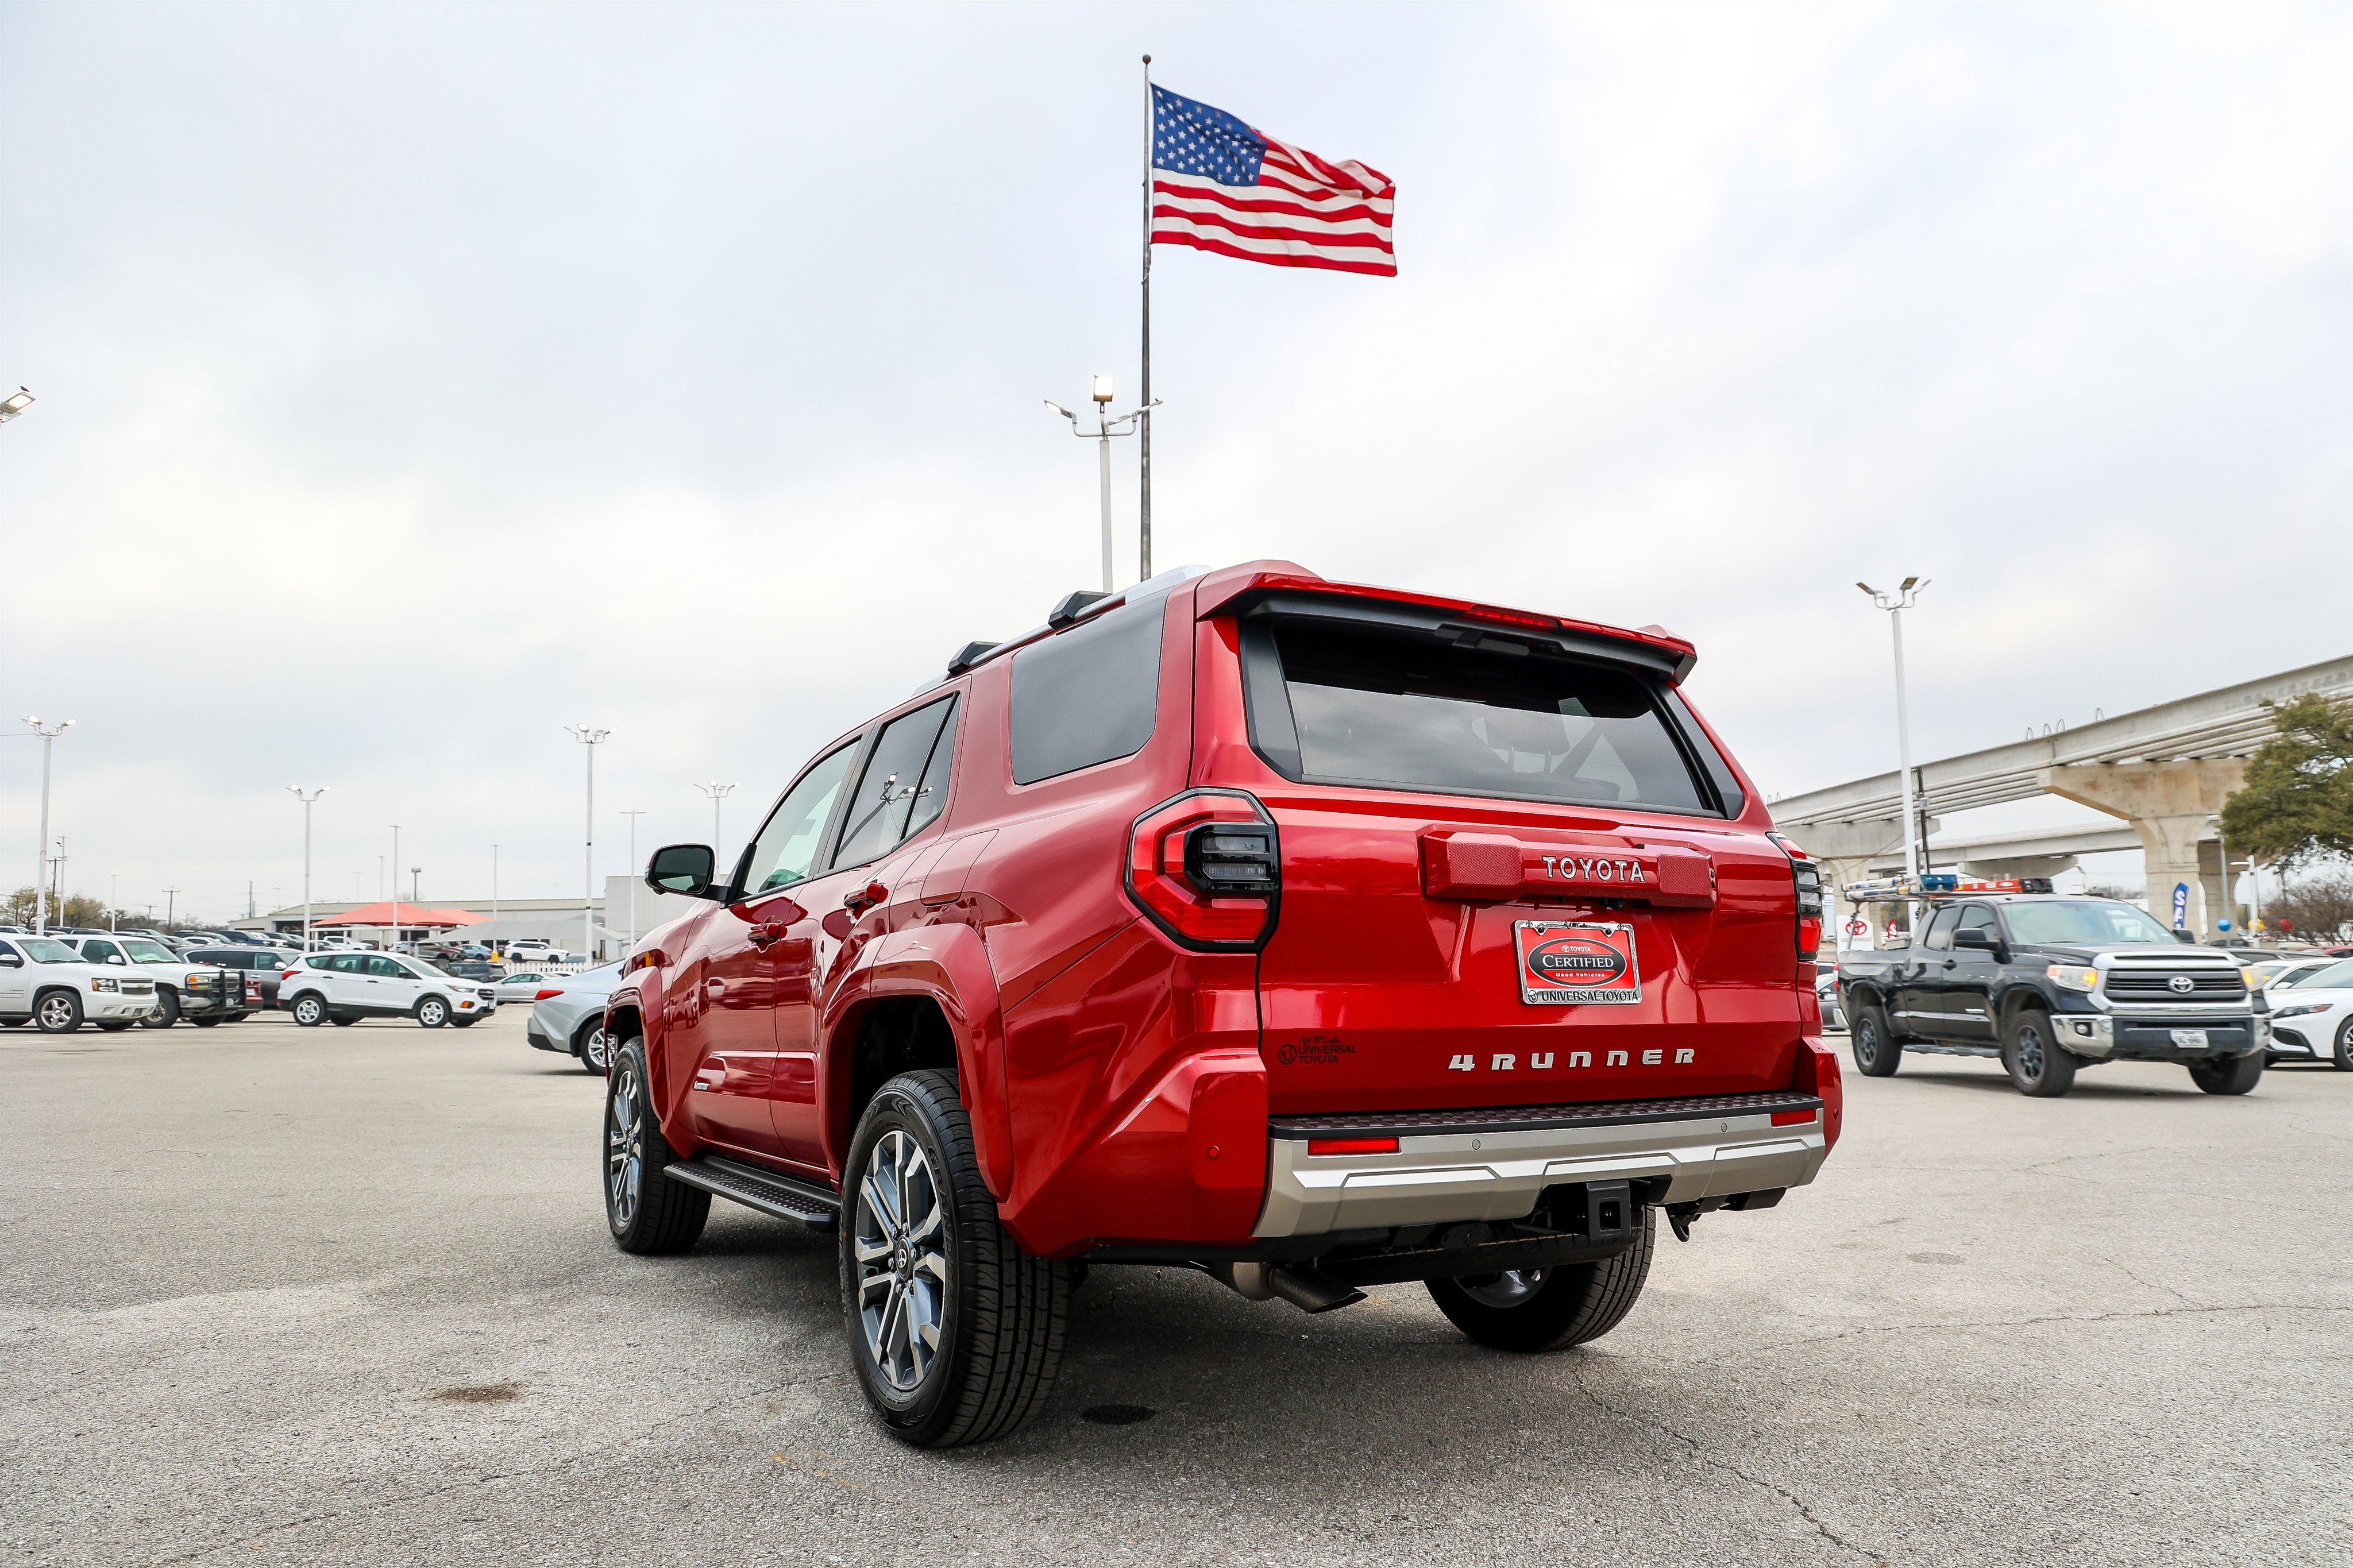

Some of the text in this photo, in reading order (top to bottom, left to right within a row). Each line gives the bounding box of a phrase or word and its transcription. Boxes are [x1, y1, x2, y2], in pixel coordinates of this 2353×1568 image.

[1542, 855, 1645, 883] TOYOTA
[1542, 955, 1614, 968] CERTIFIED
[1541, 990, 1638, 1002] UNIVERSAL TOYOTA
[1299, 1044, 1357, 1055] UNIVERSAL
[1299, 1055, 1338, 1065] TOYOTA
[1448, 1048, 1695, 1071] 4RUNNER
